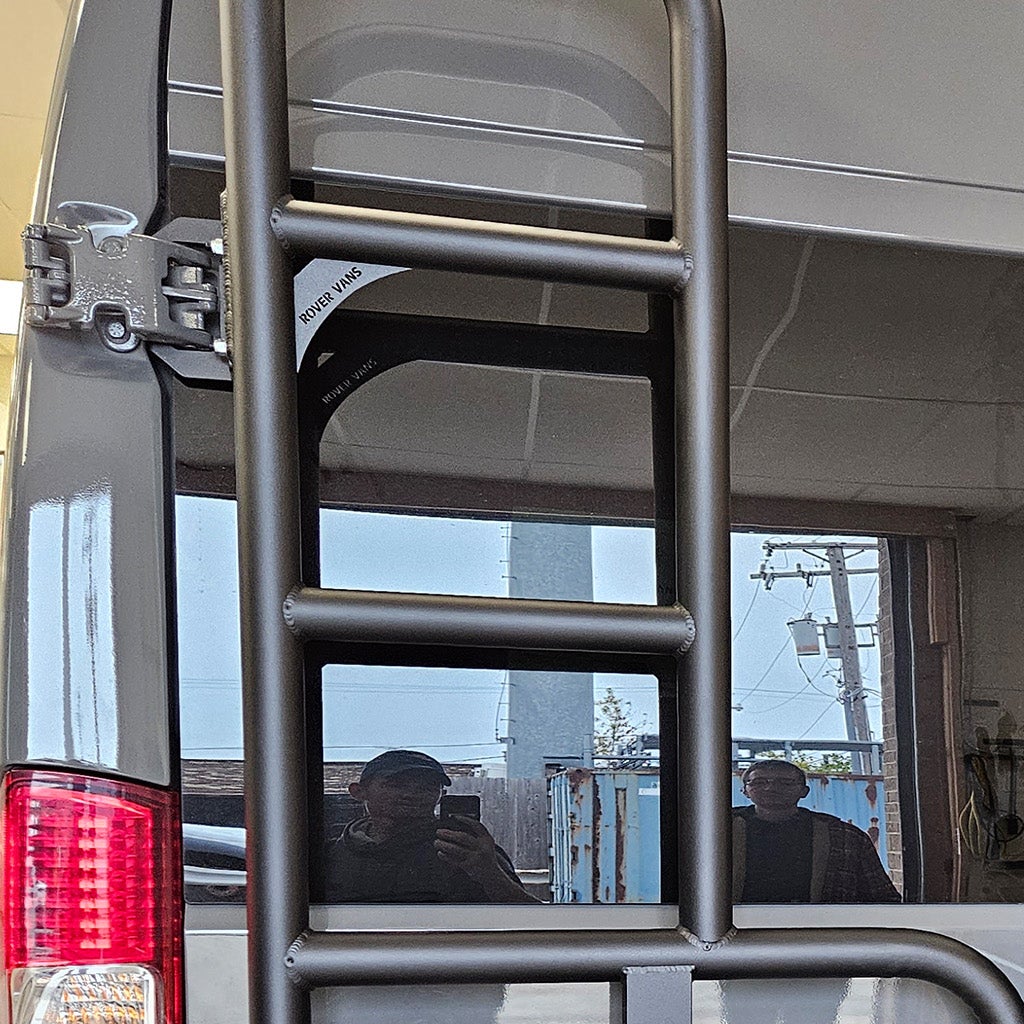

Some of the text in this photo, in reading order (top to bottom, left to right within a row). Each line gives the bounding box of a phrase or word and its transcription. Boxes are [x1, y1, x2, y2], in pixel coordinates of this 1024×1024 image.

[298, 266, 363, 325] ROVER VANS
[321, 357, 378, 405] ROVER VANS
